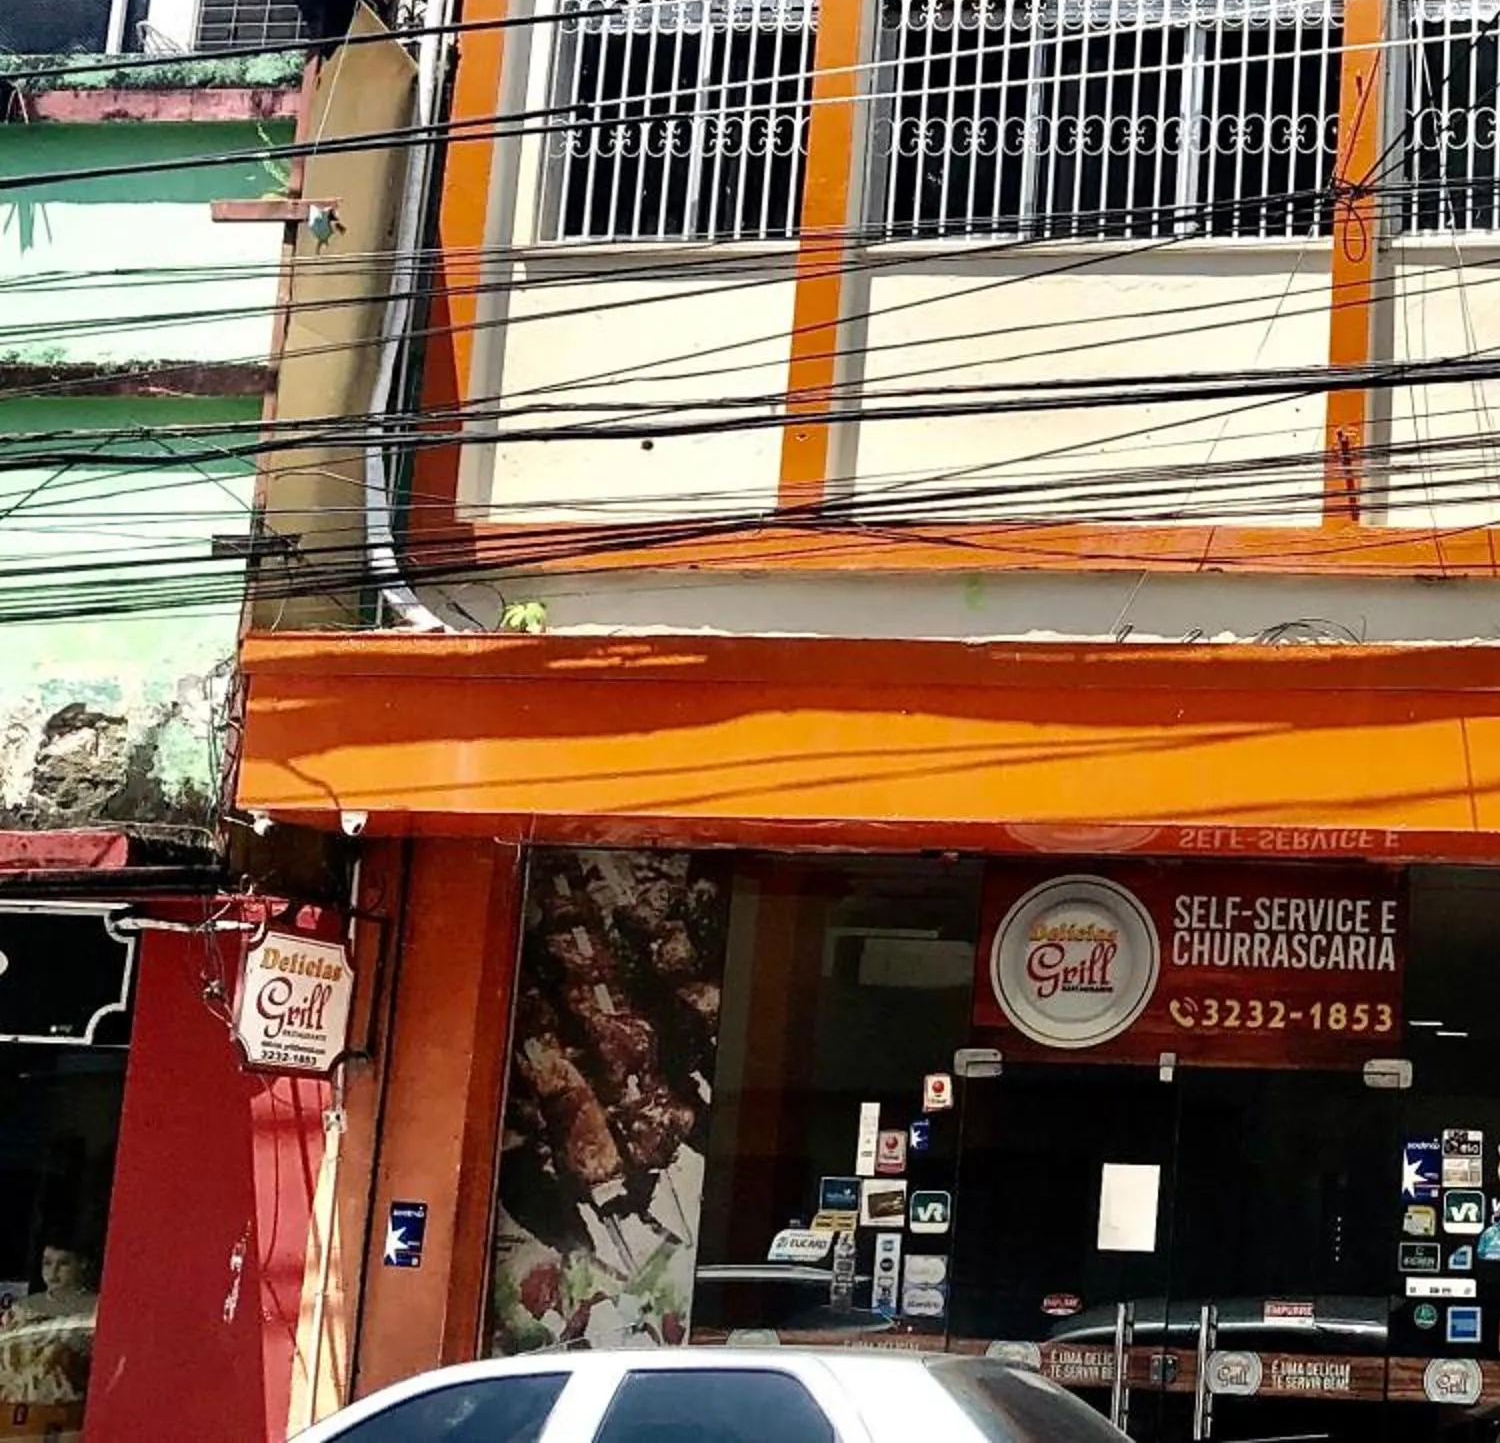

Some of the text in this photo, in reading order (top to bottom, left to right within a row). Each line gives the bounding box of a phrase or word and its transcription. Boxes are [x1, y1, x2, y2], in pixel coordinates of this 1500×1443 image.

[1174, 895, 1397, 934] SELF-SERVICE E
[1027, 942, 1118, 998] Grill
[1173, 931, 1396, 972] CHURRASCARIA
[256, 976, 333, 1039] Grill
[1201, 997, 1393, 1032] 3232-1853
